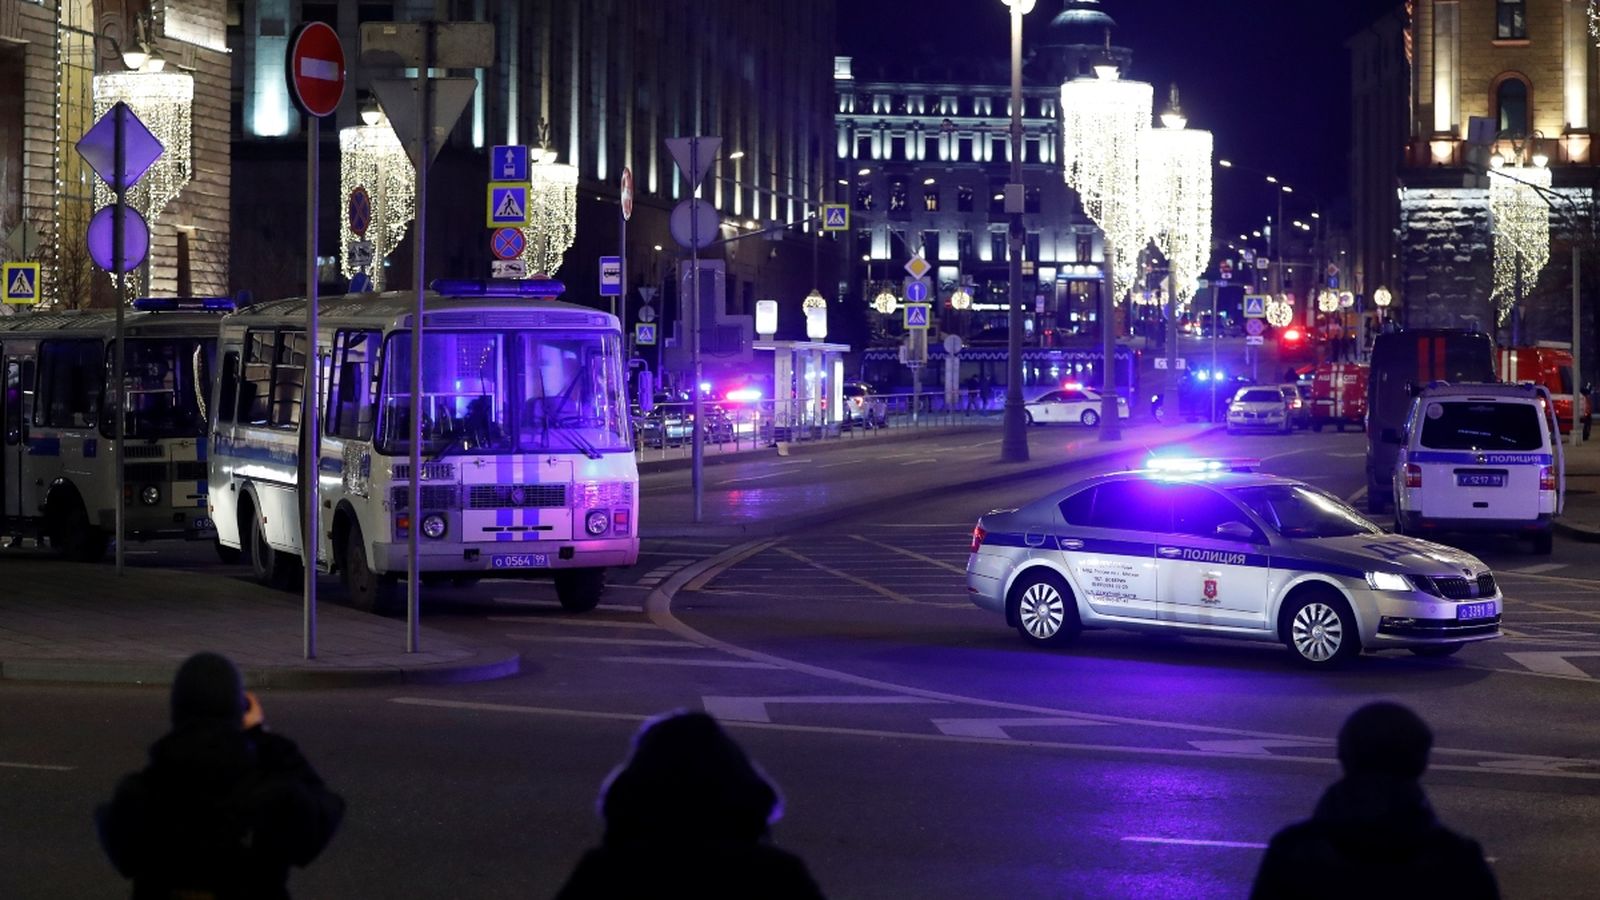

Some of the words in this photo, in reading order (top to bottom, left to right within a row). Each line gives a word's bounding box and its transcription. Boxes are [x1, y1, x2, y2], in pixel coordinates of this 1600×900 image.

[1490, 455, 1541, 464] ПОЛИЦИЯ
[505, 556, 530, 566] 0564
[1183, 548, 1246, 565] ПОЛИЦИЯ
